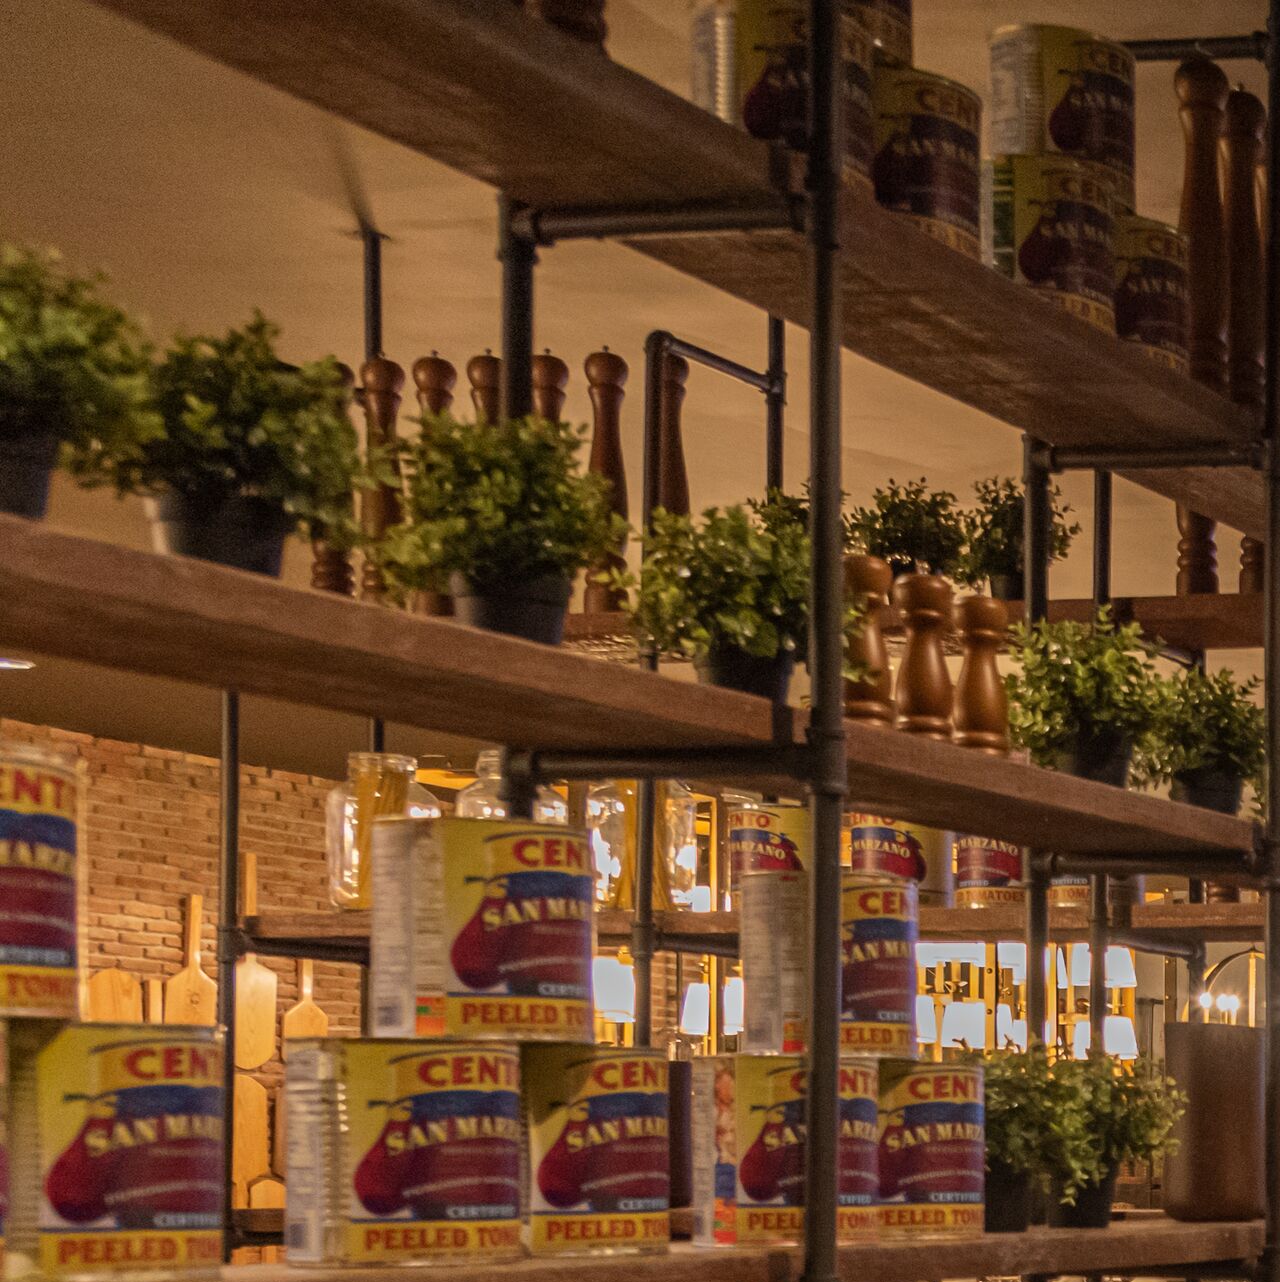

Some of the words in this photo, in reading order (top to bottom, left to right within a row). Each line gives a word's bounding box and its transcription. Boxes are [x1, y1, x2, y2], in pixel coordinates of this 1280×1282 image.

[461, 1003, 557, 1025] PEELED
[886, 1125, 931, 1152] SAN
[364, 1228, 470, 1251] PEELED
[545, 1220, 637, 1242] PEELED
